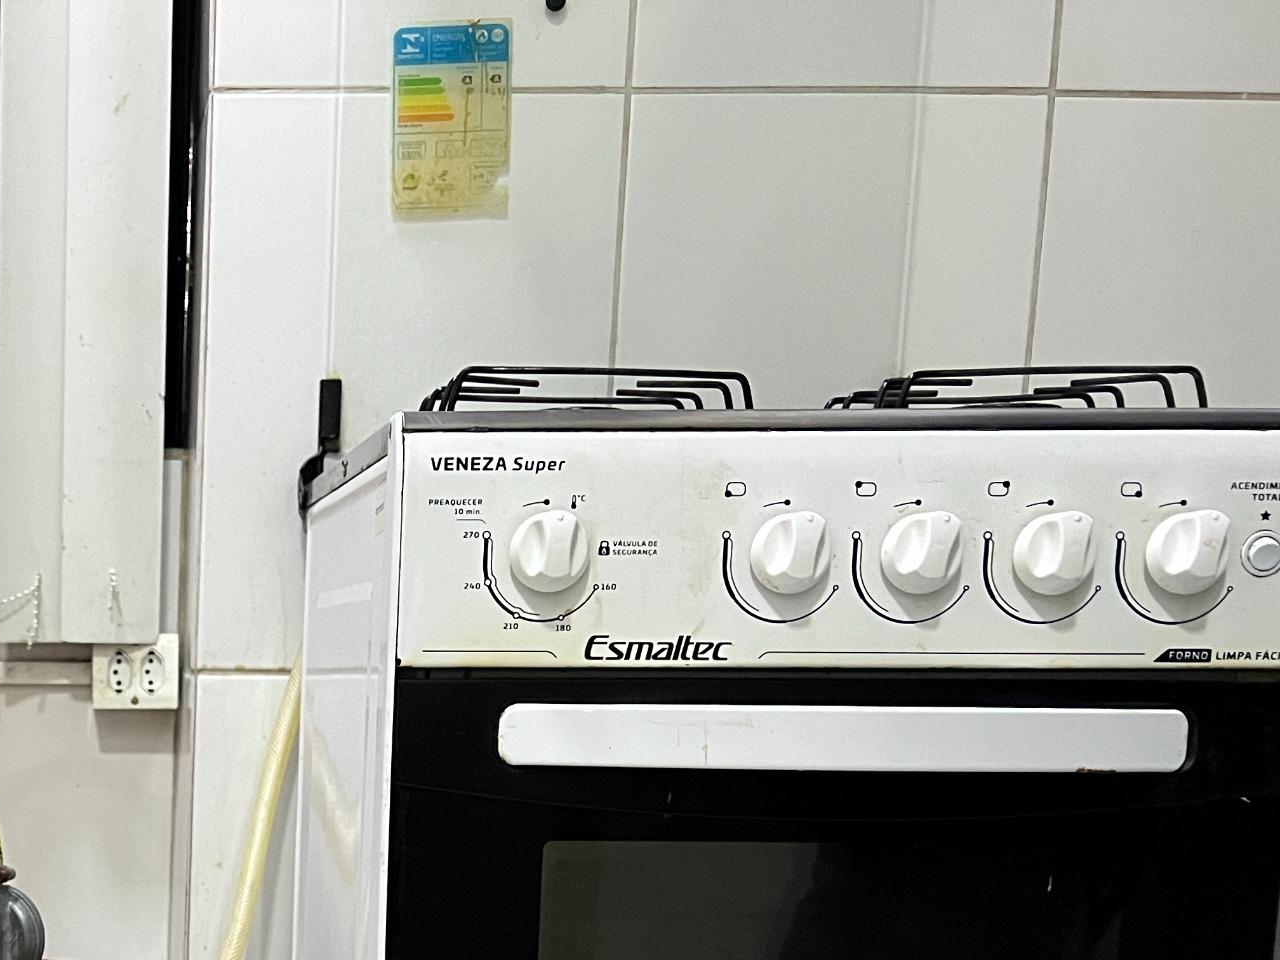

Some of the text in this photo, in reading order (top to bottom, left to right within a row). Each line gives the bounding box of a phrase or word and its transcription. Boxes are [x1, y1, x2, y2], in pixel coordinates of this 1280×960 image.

[430, 456, 566, 474] VENEZA Super
[428, 498, 483, 506] PREAQUECER
[463, 531, 480, 539] 270
[463, 582, 481, 590] 240
[584, 635, 733, 661] Esmaltec
[1168, 651, 1209, 660] FORNO
[1215, 651, 1252, 660] LIMPA
